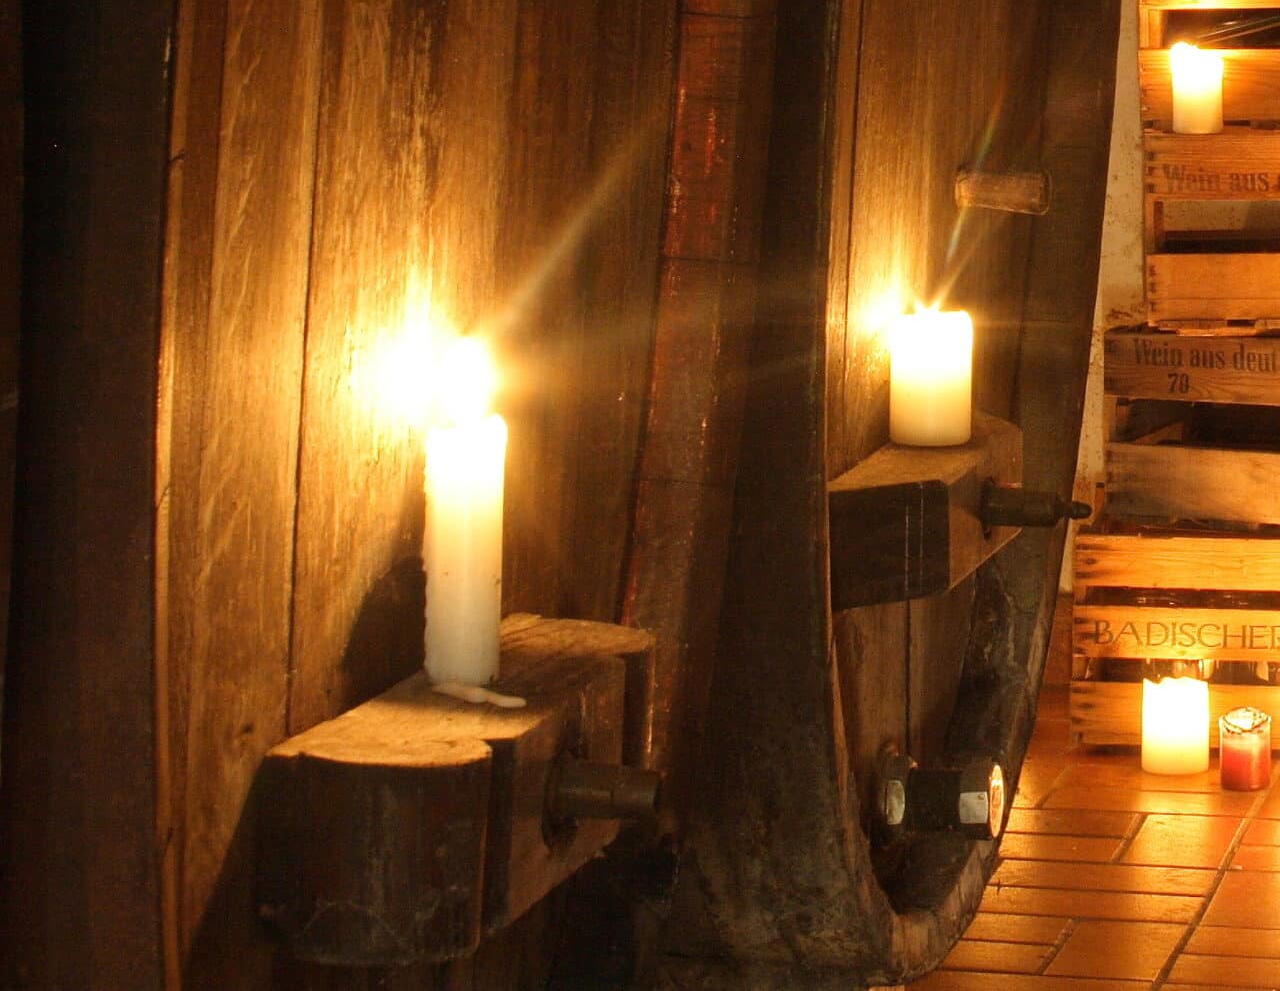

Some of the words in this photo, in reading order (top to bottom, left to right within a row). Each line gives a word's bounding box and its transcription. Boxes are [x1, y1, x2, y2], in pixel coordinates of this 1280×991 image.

[1163, 164, 1221, 194] Wein
[1229, 169, 1269, 193] aus
[1134, 338, 1182, 367] Wein
[1190, 346, 1226, 369] aus
